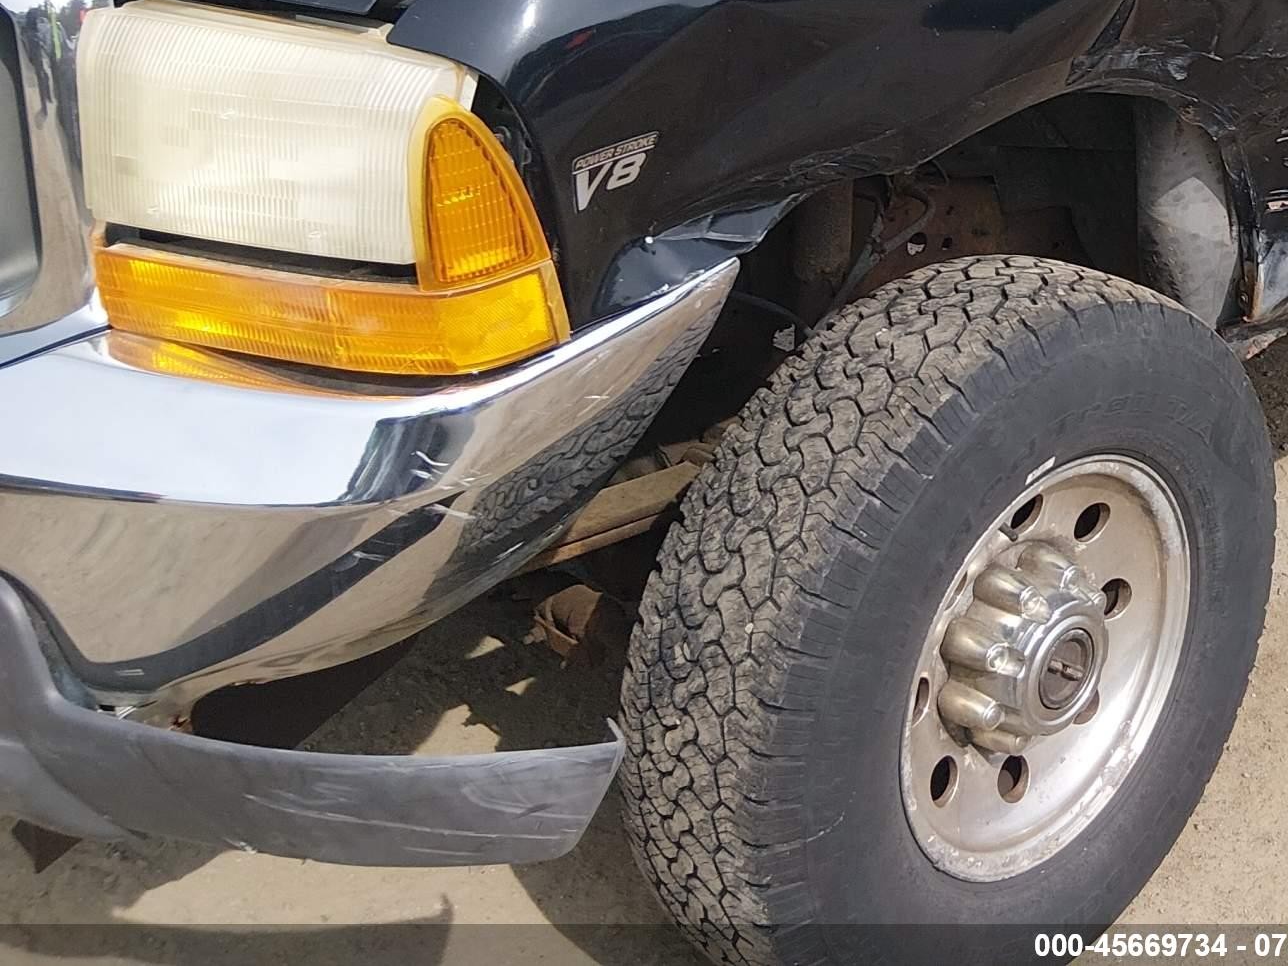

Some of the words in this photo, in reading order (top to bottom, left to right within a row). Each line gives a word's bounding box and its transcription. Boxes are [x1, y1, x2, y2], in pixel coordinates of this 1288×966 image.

[575, 149, 615, 169] POWER
[614, 136, 658, 157] STROKE
[575, 152, 647, 212] V8
